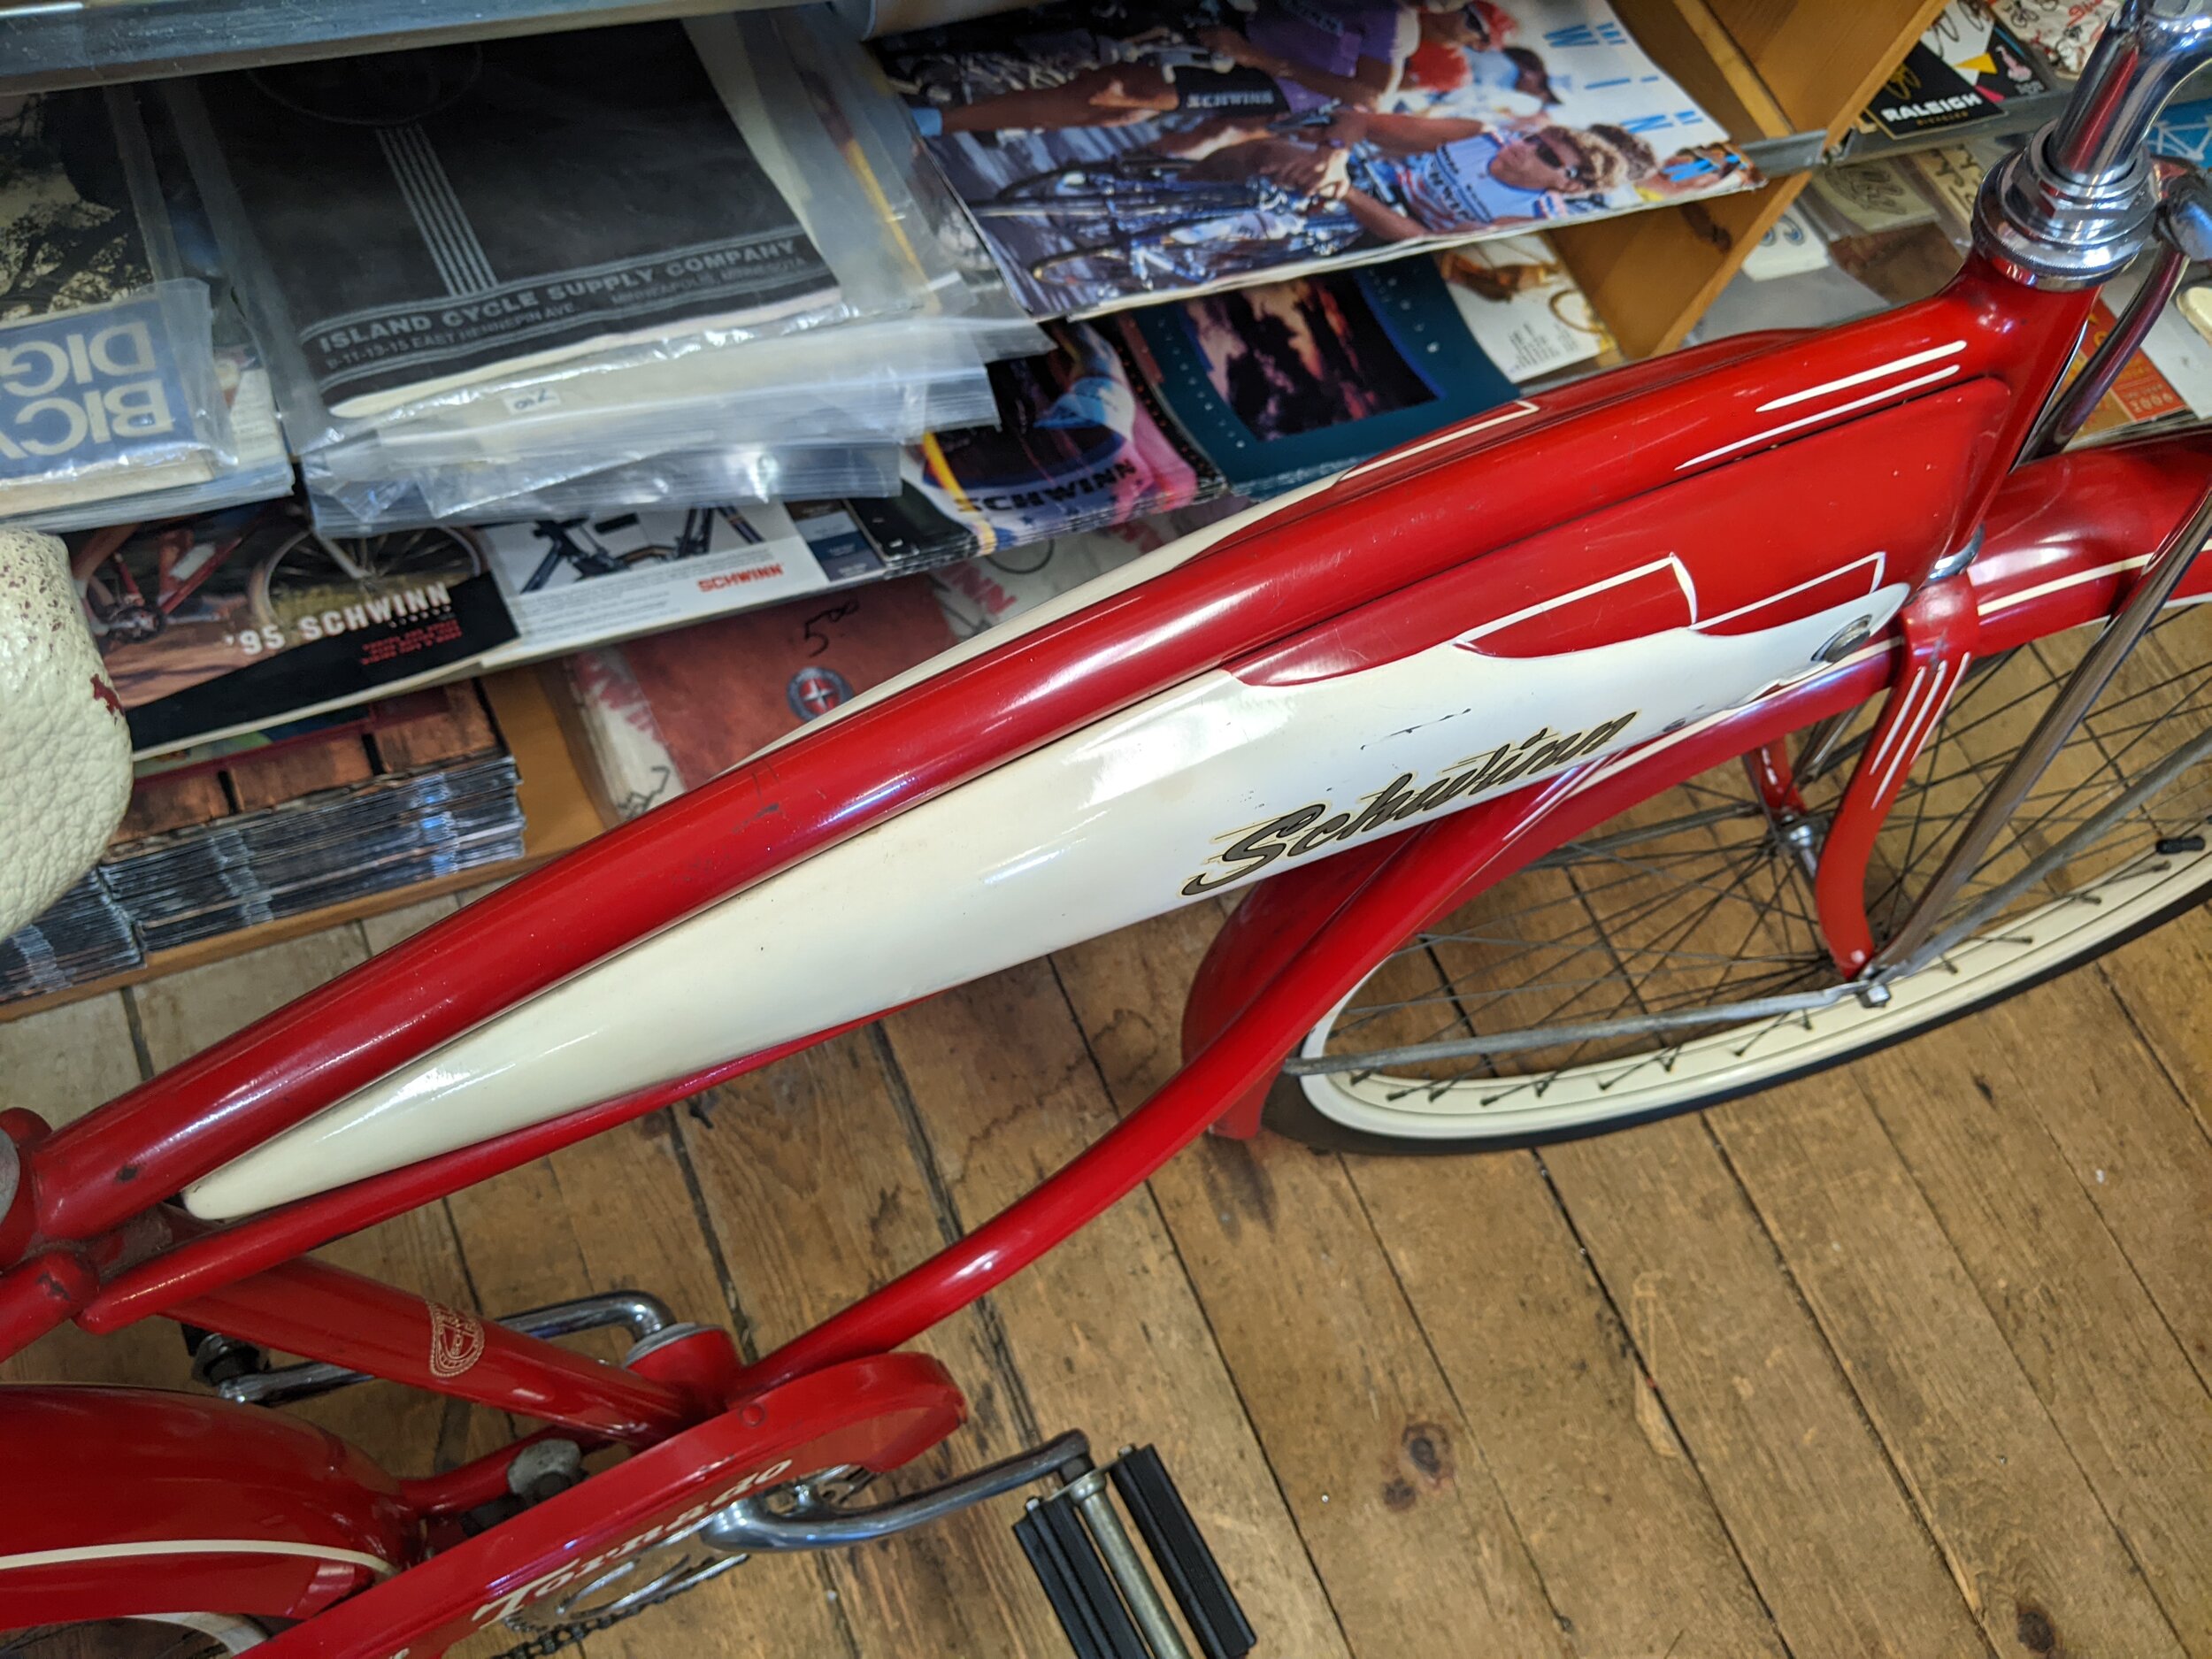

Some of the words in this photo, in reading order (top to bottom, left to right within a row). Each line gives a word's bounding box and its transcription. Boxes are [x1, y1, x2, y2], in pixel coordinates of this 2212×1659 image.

[1880, 92, 1984, 124] RALEIGH
[319, 314, 433, 353] ISLAND
[443, 292, 539, 328] CYCLE
[549, 268, 655, 301] SUPPLY
[665, 240, 795, 277] COMPANY
[411, 333, 456, 355] EAST
[953, 458, 1137, 514] SCHWINN
[697, 563, 784, 594] SCHWINN
[225, 624, 286, 656] '95
[299, 581, 452, 641] SCHWINN
[1181, 710, 1639, 896] Schwinn
[472, 1459, 792, 1628] Tornado
